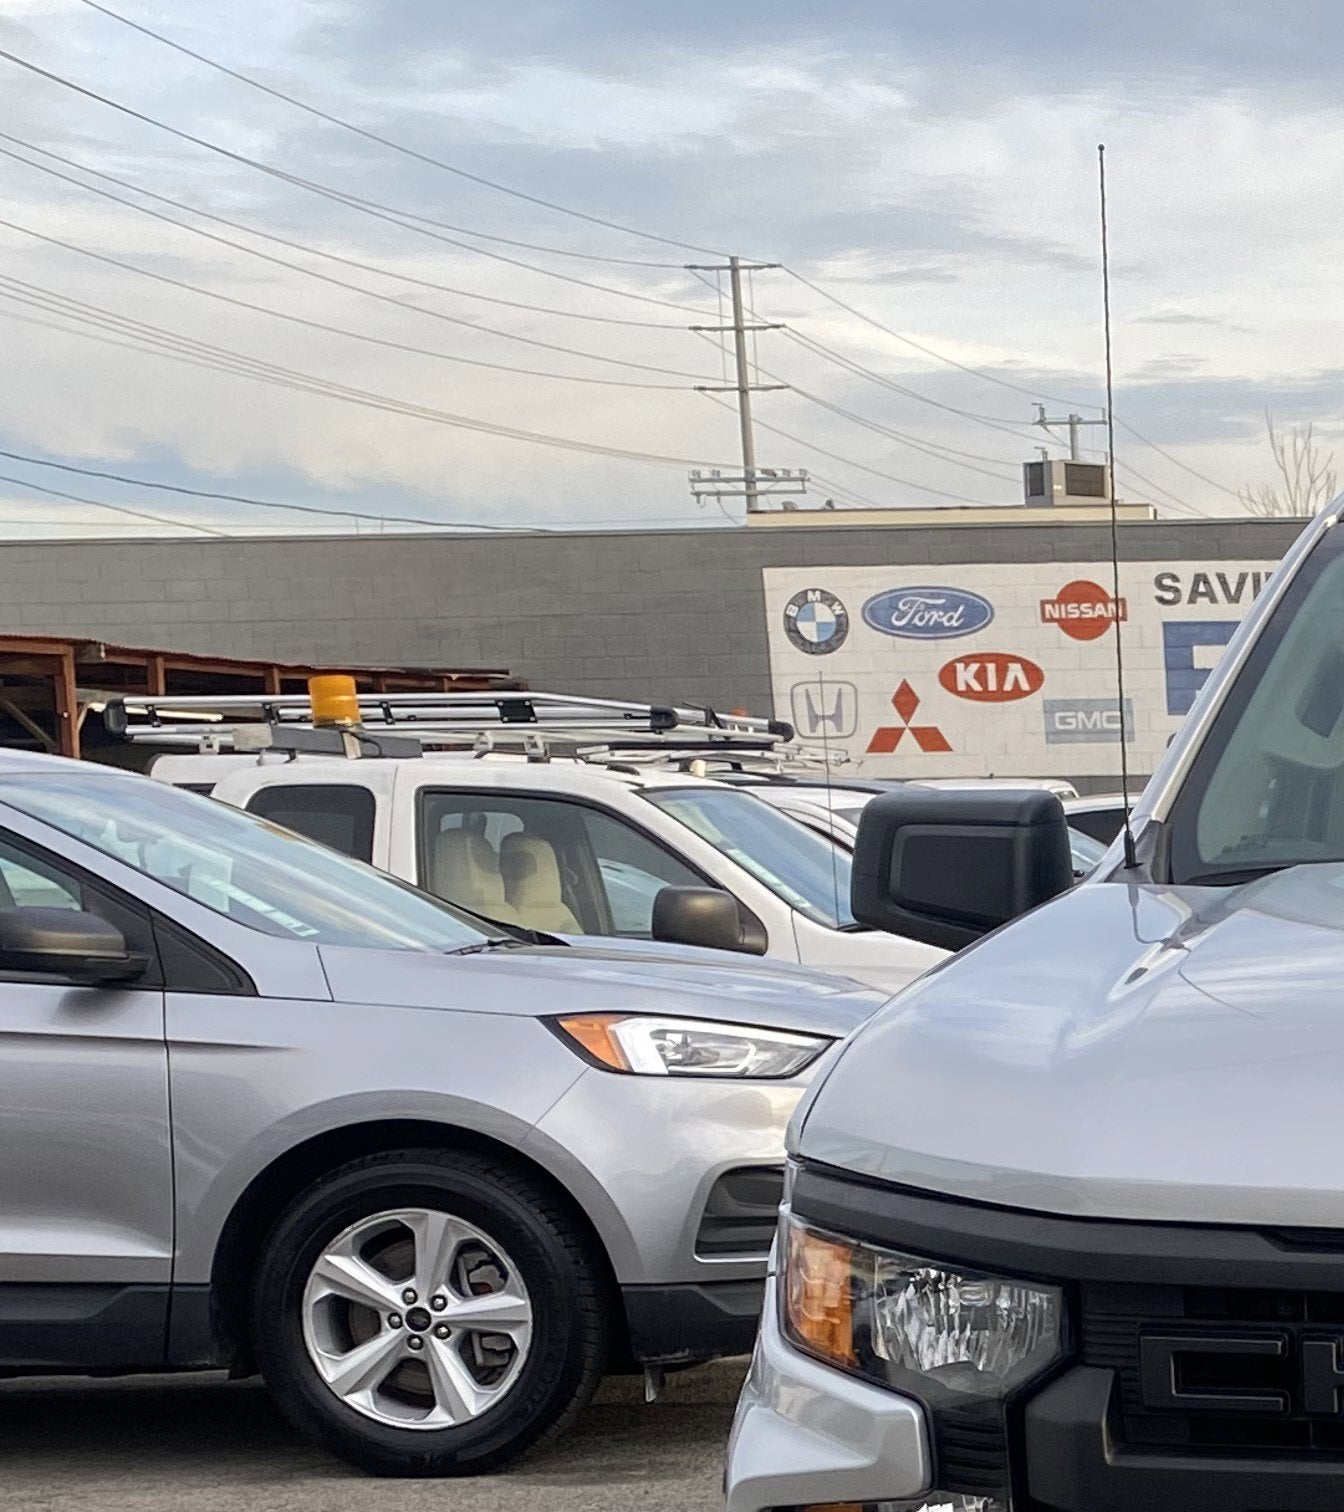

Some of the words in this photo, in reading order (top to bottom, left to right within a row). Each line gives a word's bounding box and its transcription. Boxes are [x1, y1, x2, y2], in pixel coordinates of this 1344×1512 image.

[1154, 572, 1274, 606] SAVI
[890, 596, 965, 629] Ford
[1044, 603, 1123, 619] NISSAN
[953, 662, 1032, 692] KIA
[1054, 710, 1122, 730] GMC
